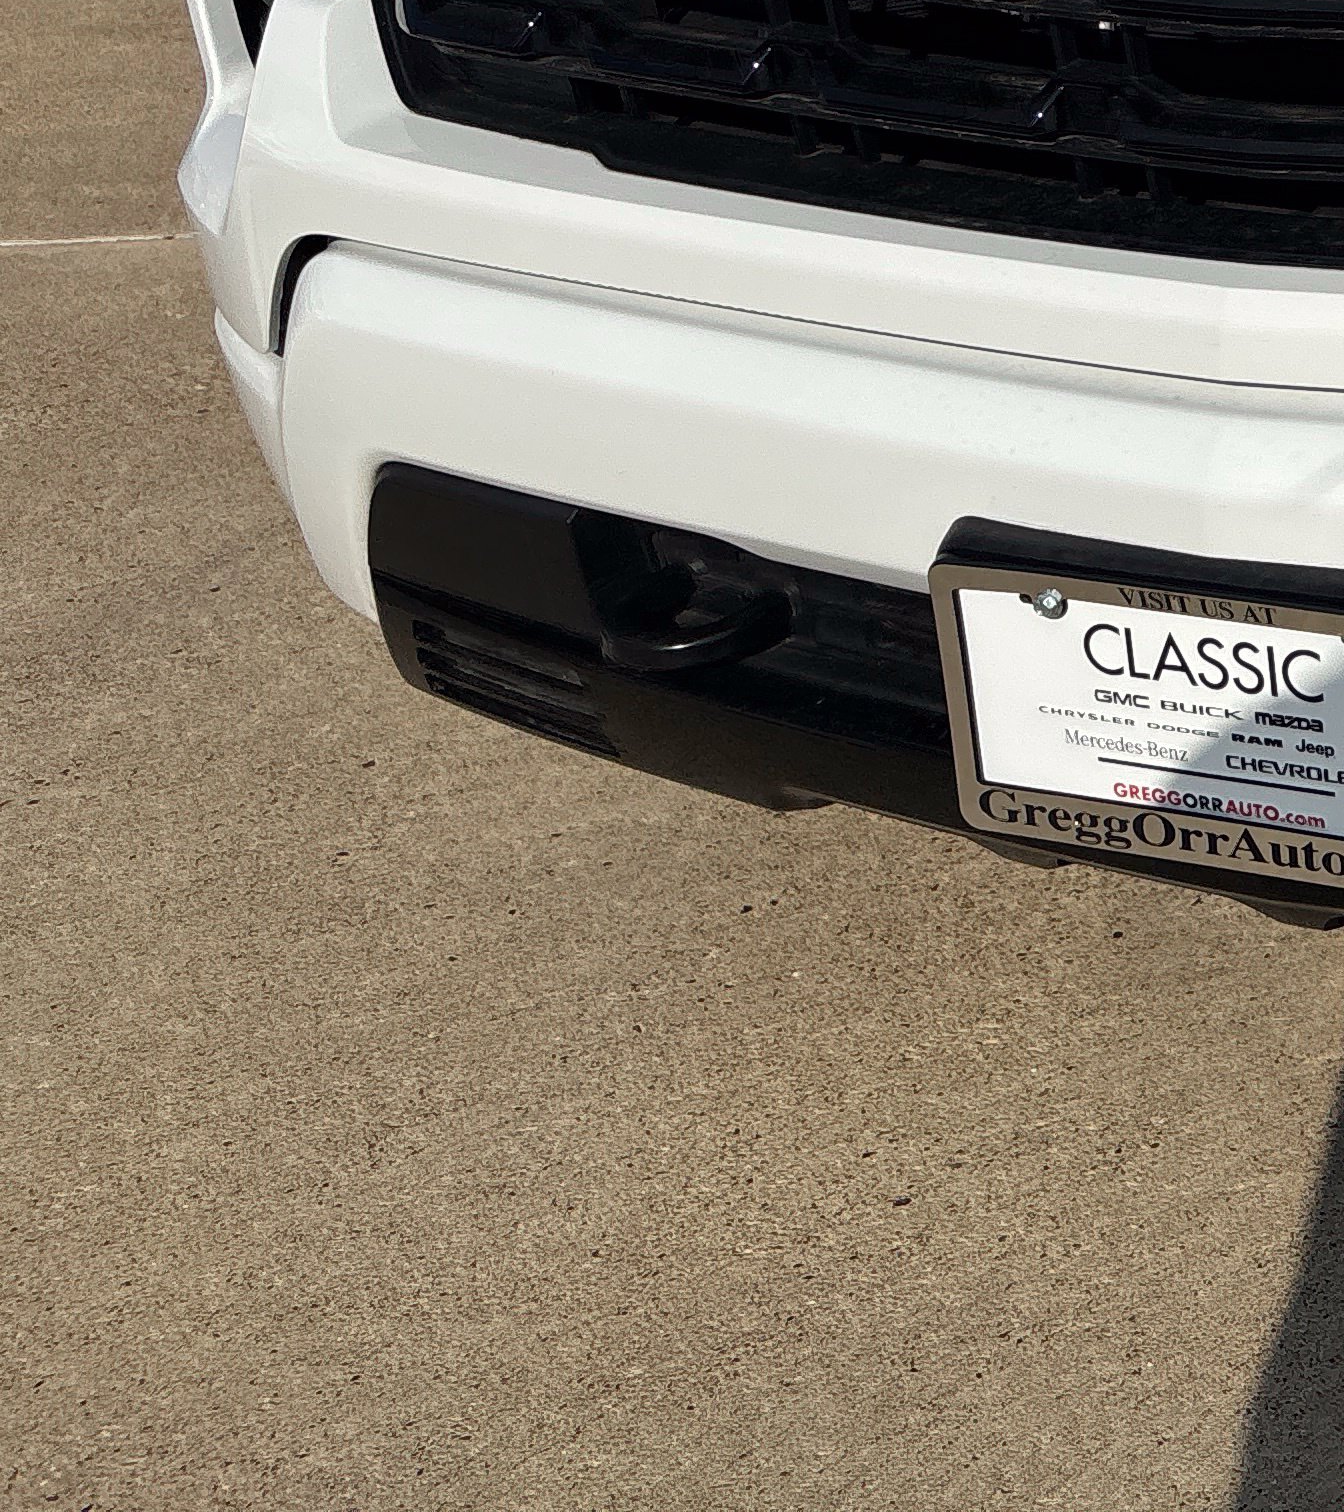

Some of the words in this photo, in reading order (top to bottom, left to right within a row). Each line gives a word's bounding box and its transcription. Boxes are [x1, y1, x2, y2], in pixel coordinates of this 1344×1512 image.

[1117, 587, 1191, 614] VISIT
[1199, 599, 1234, 620] US
[1242, 604, 1277, 626] AT
[1083, 623, 1325, 703] CLASSIC
[1094, 689, 1151, 710] GMC
[1160, 700, 1244, 721] BUICK
[1038, 705, 1136, 727] CHRYSLER
[1147, 722, 1220, 739] DODGE
[1231, 733, 1284, 748] RAM
[1295, 739, 1335, 758] Jeep
[1064, 728, 1190, 763] Mercedes-Benz
[1113, 782, 1326, 829] GREGGORRAUTO.com
